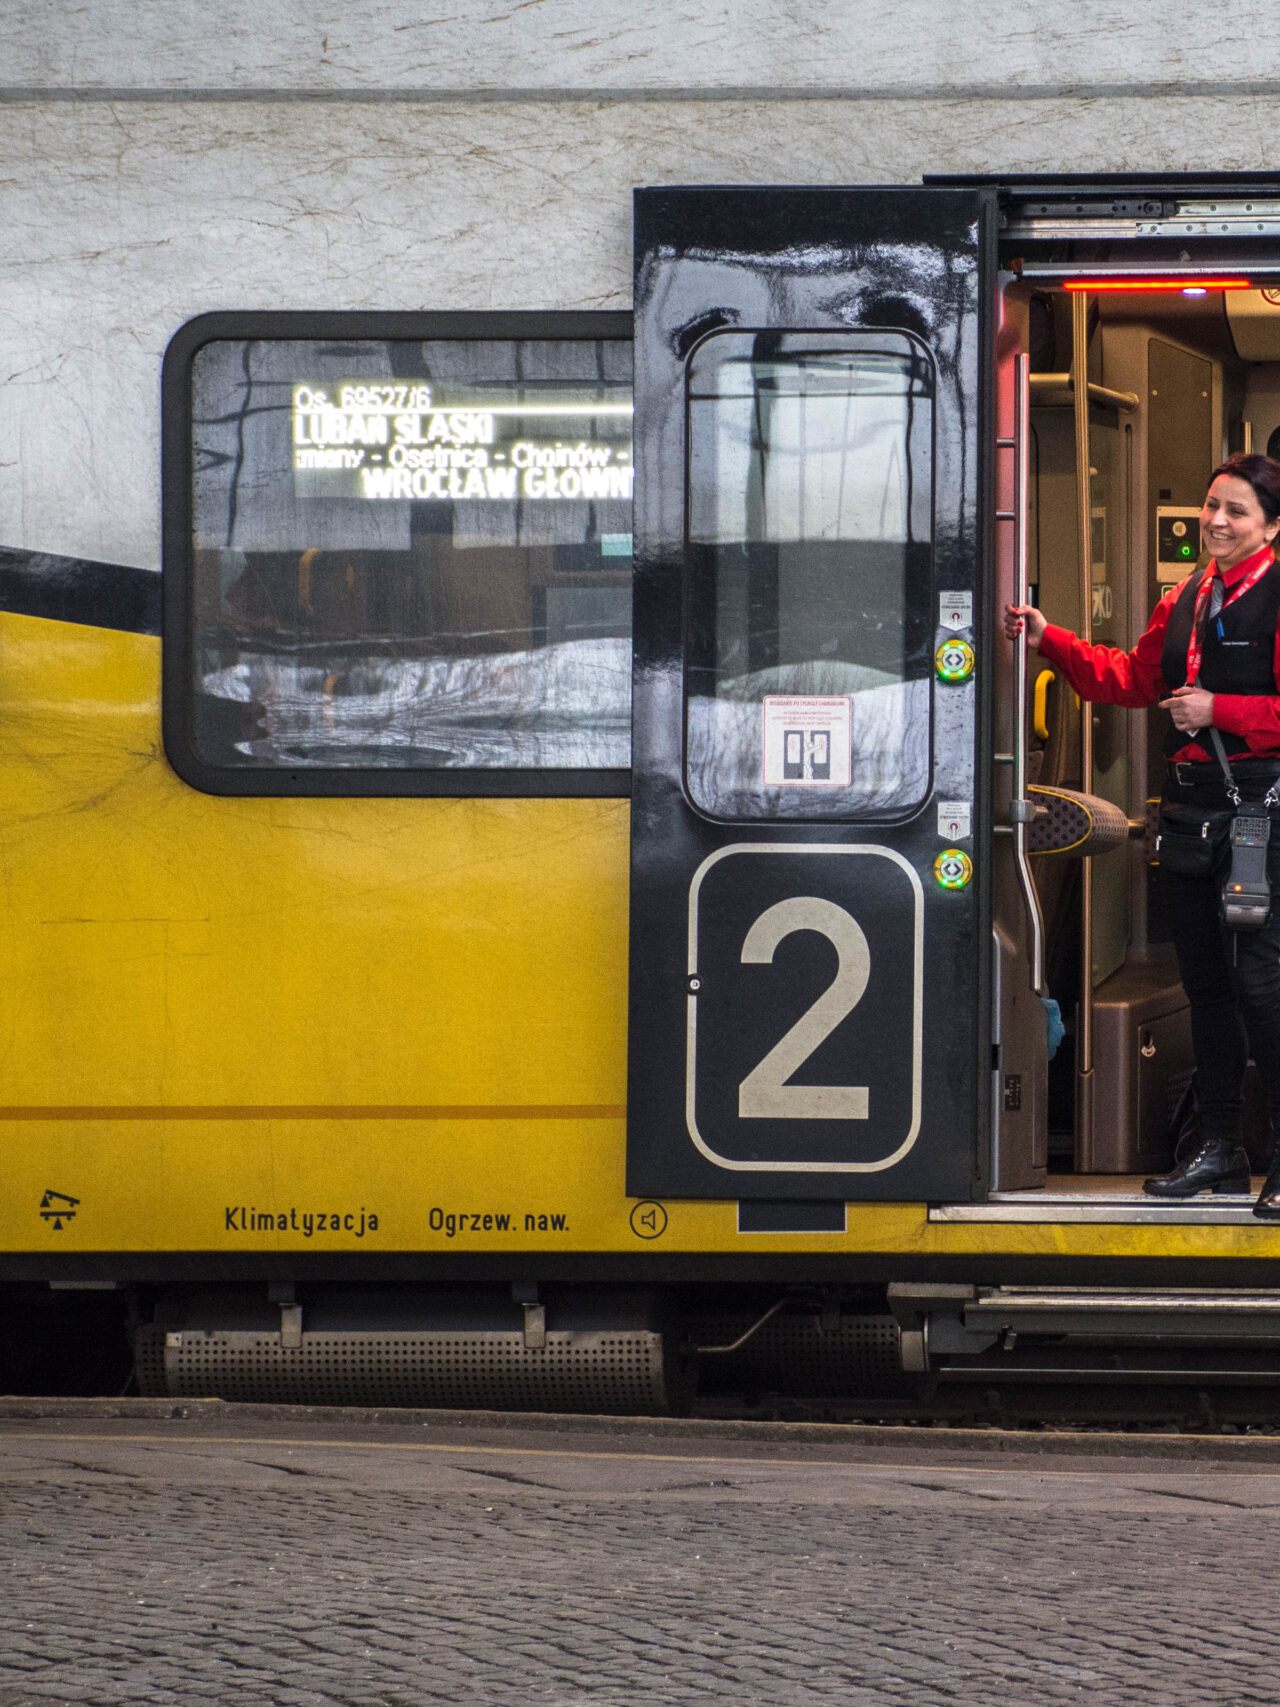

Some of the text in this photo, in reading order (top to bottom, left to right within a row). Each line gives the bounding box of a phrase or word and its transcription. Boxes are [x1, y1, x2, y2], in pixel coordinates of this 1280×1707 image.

[296, 387, 431, 409] Os. 69527/6
[390, 444, 488, 468] Osetnica
[362, 467, 636, 499] WROCŁAW GŁÓWN
[738, 896, 871, 1120] 2
[225, 1207, 379, 1238] Klimatyzacja
[429, 1207, 570, 1237] Ogrzew. naw.
